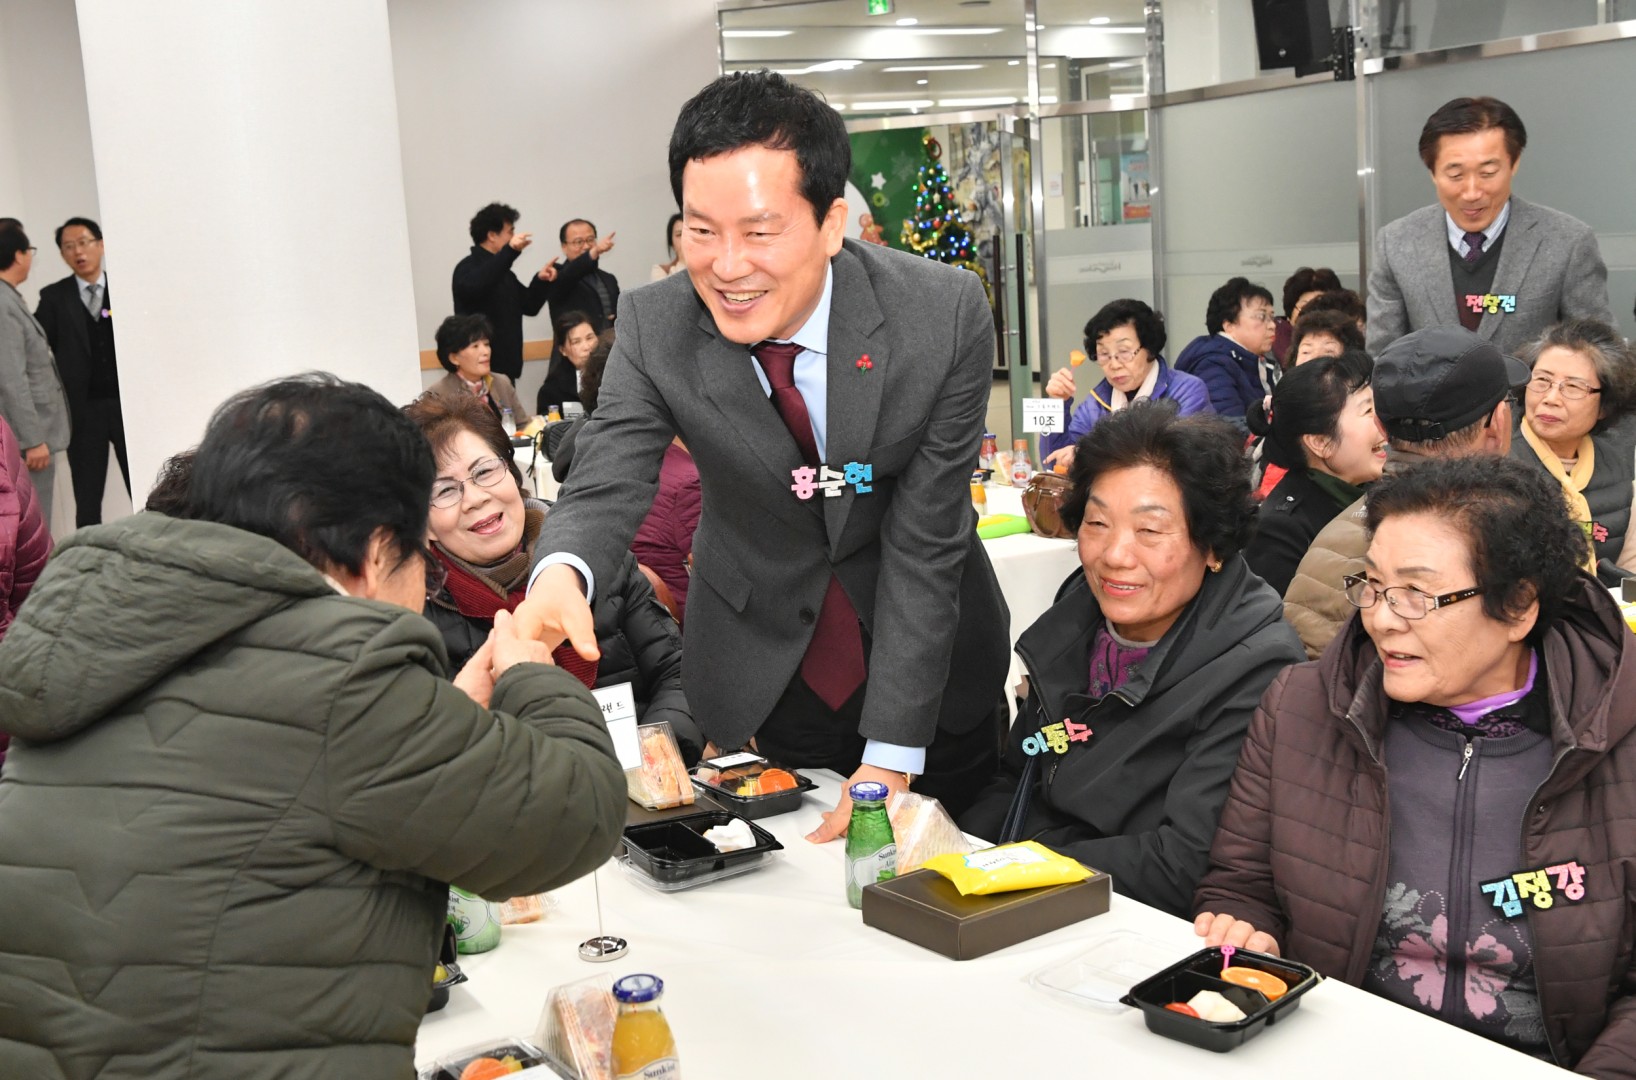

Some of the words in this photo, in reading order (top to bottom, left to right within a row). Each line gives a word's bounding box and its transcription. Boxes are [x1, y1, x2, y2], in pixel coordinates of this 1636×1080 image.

[1033, 415, 1056, 426] 10조
[791, 461, 873, 500] 홍순현
[1481, 861, 1586, 918] 김정강
